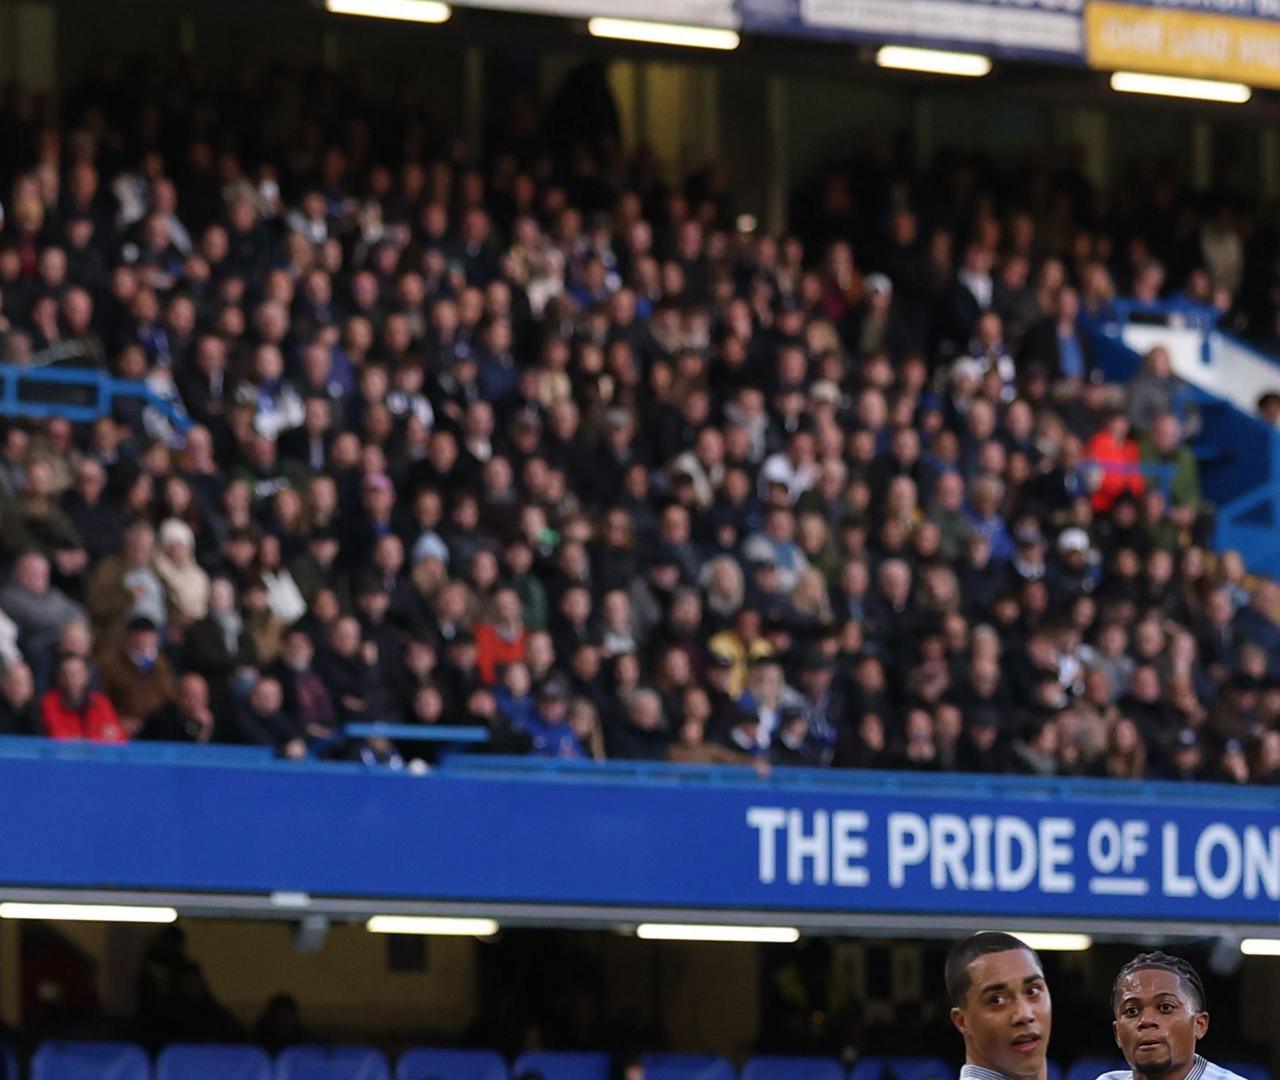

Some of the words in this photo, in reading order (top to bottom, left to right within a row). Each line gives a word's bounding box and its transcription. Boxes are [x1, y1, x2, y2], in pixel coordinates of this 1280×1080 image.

[747, 807, 869, 886] THE
[888, 811, 1075, 894] PRIDE
[1088, 819, 1148, 875] OF
